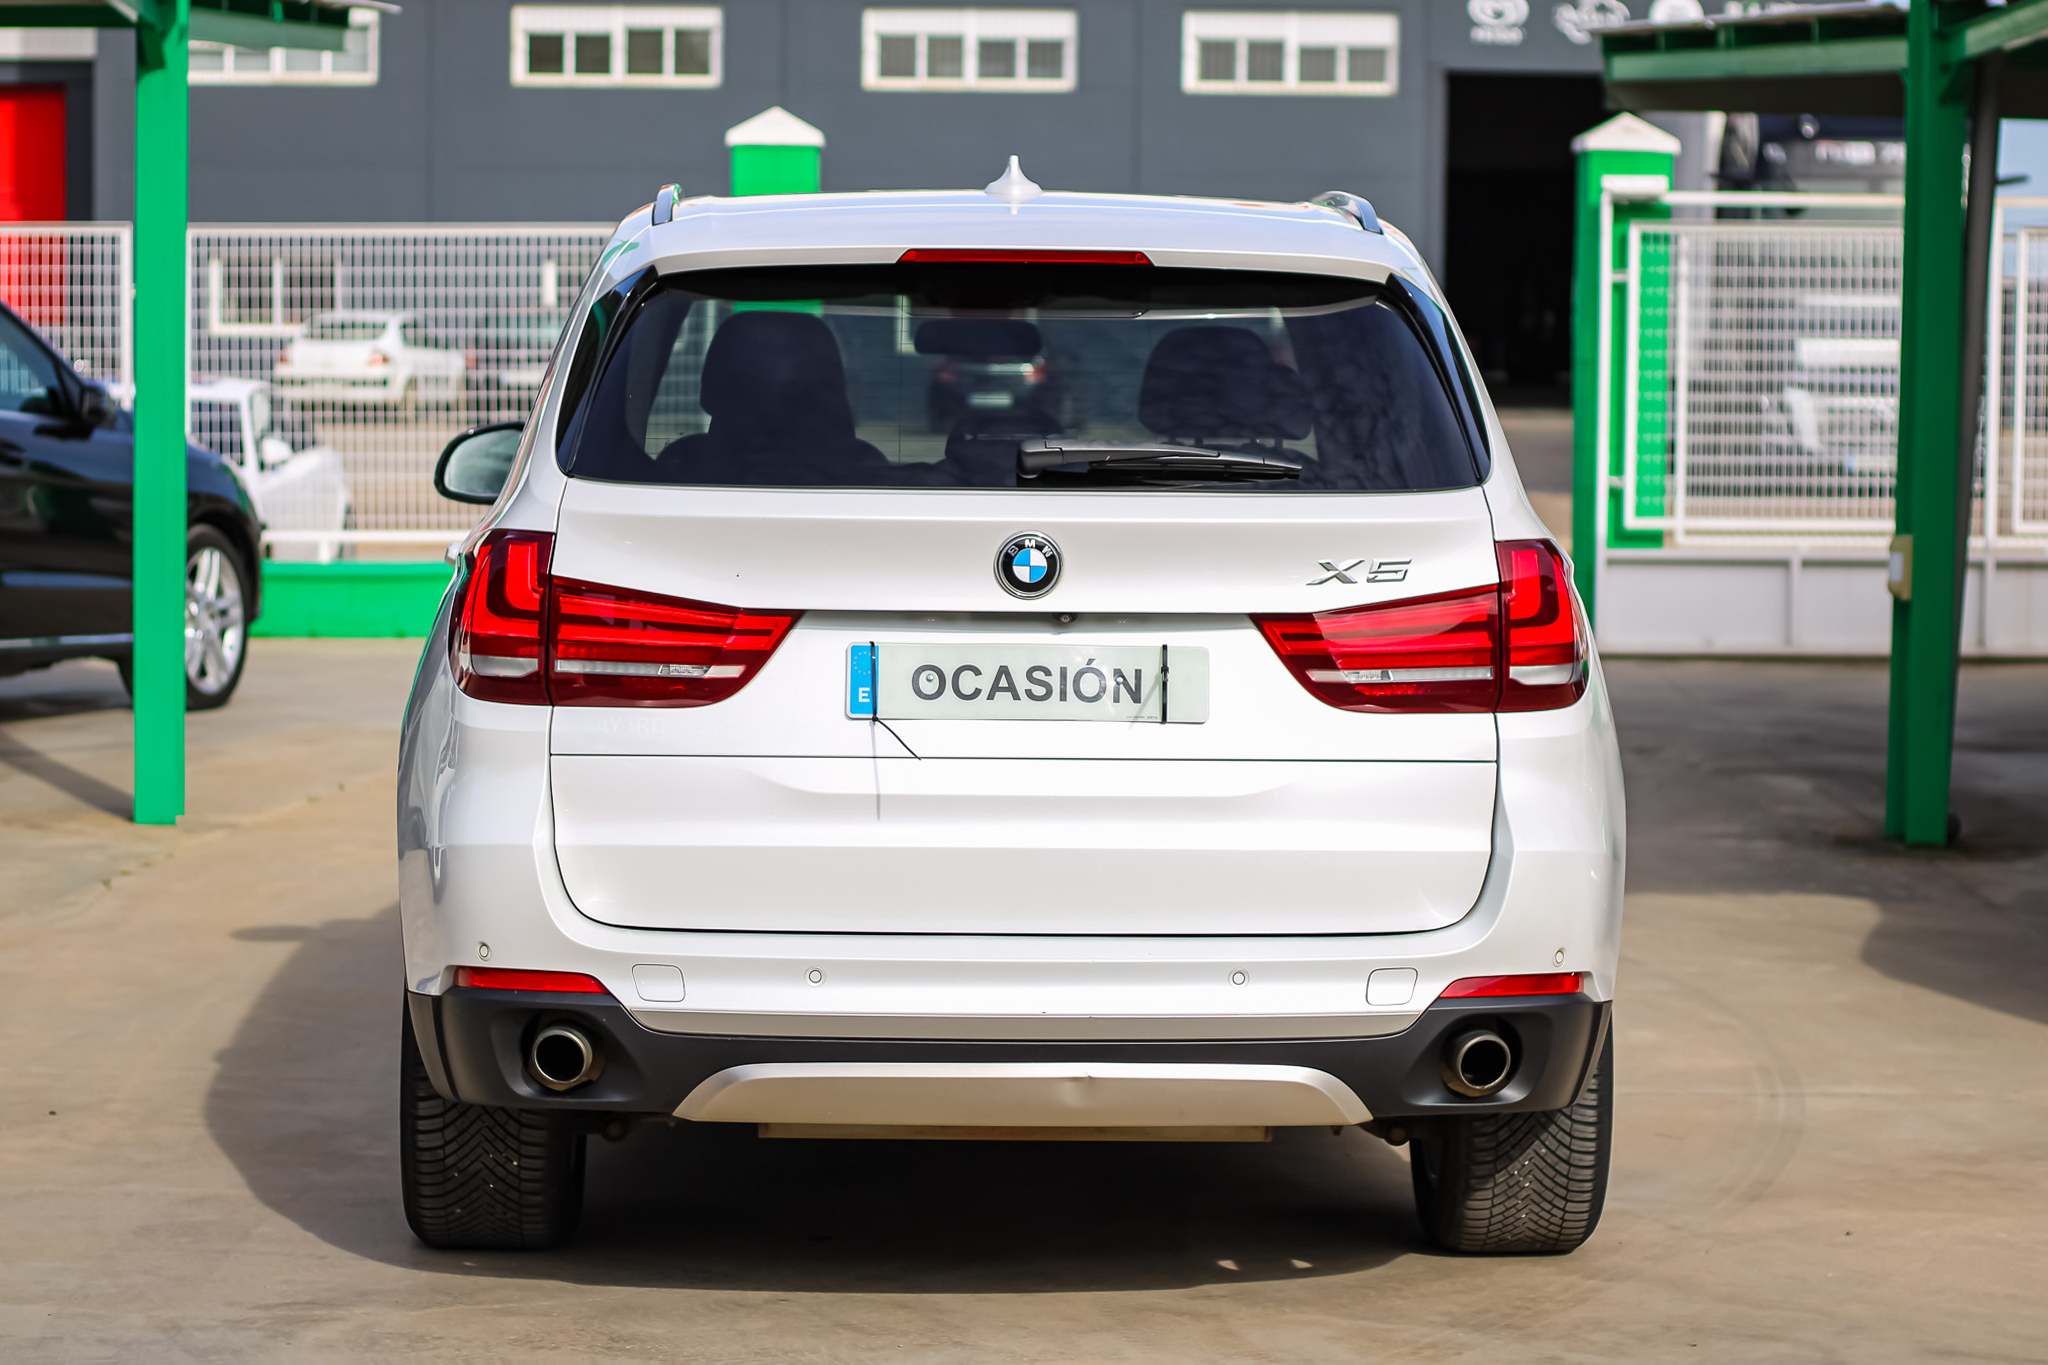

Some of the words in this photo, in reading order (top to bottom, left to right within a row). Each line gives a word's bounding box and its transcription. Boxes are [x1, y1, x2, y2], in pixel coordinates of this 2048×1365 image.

[1007, 538, 1053, 558] BMW
[1305, 559, 1413, 586] X5
[911, 658, 1142, 704] OCASIÓN
[858, 687, 871, 703] E
